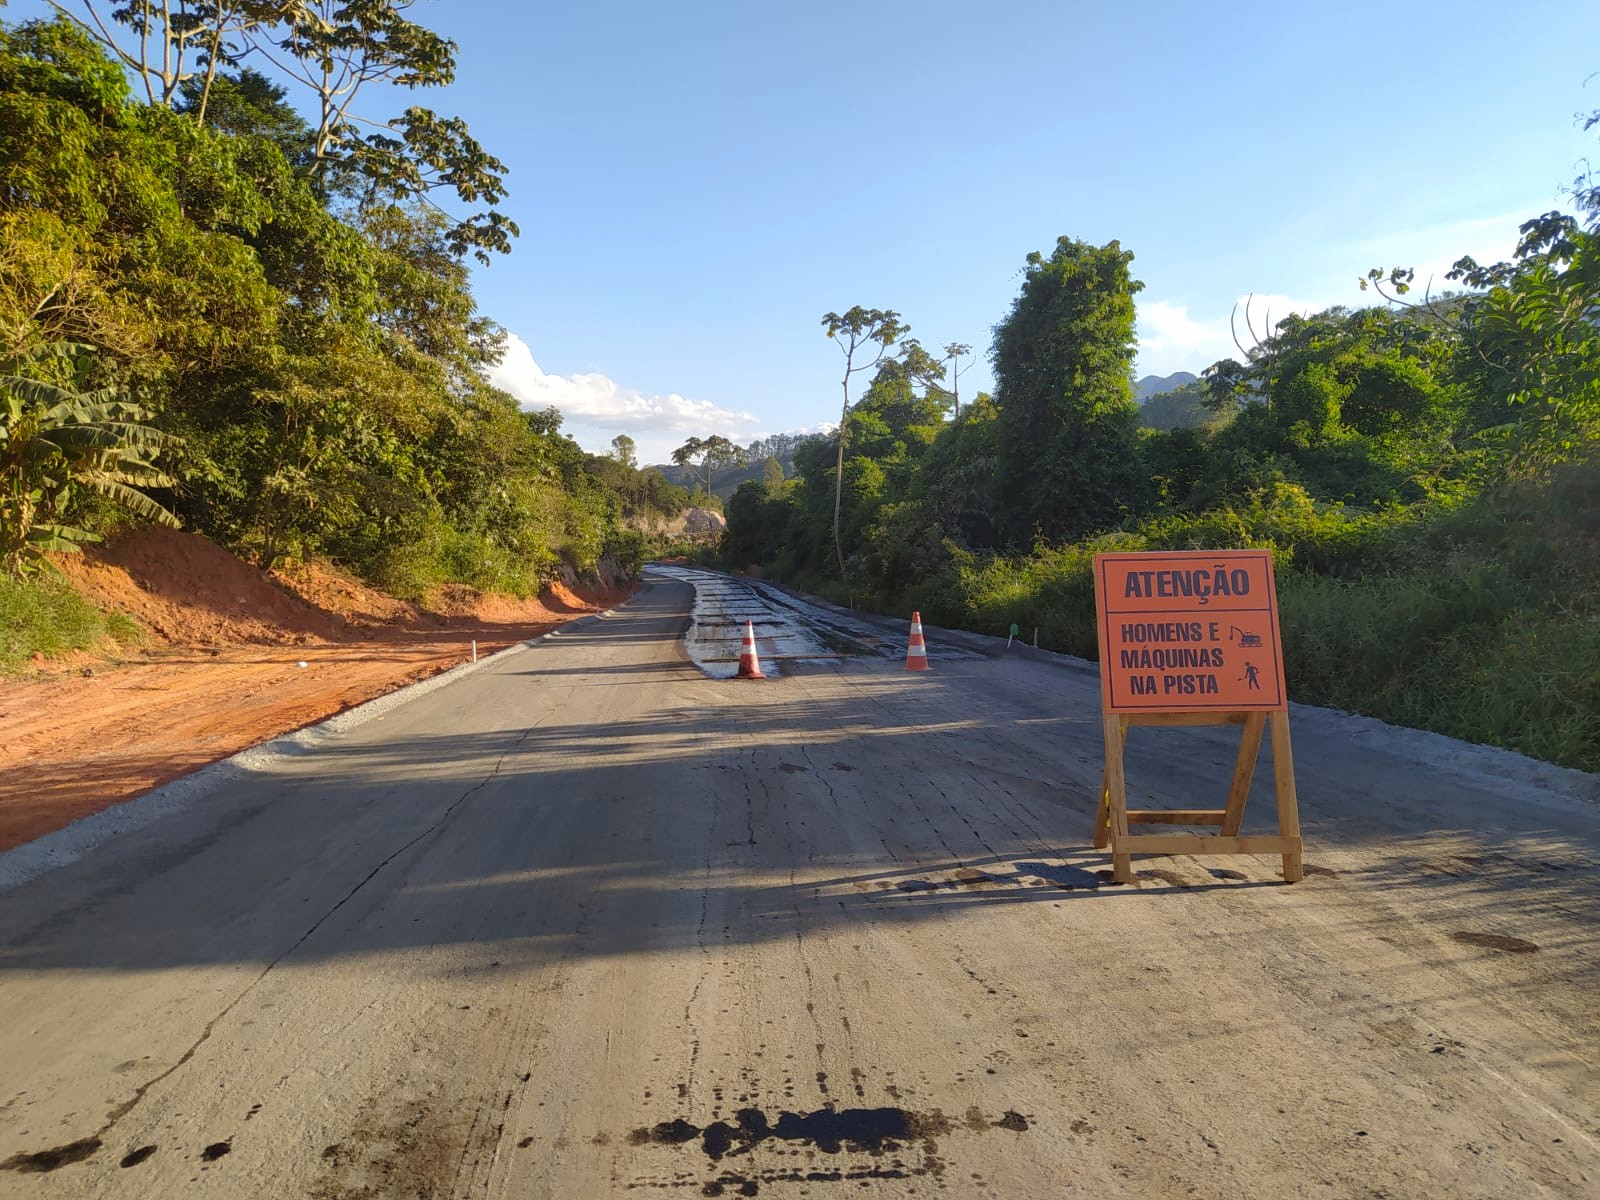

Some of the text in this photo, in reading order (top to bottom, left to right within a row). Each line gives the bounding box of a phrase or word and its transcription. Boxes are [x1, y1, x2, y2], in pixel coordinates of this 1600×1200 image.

[1124, 563, 1250, 605] ATENÇÃO
[1121, 622, 1220, 643] HOMENS E
[1120, 644, 1224, 671] MÁQUINAS
[1129, 674, 1219, 695] NA PISTA
